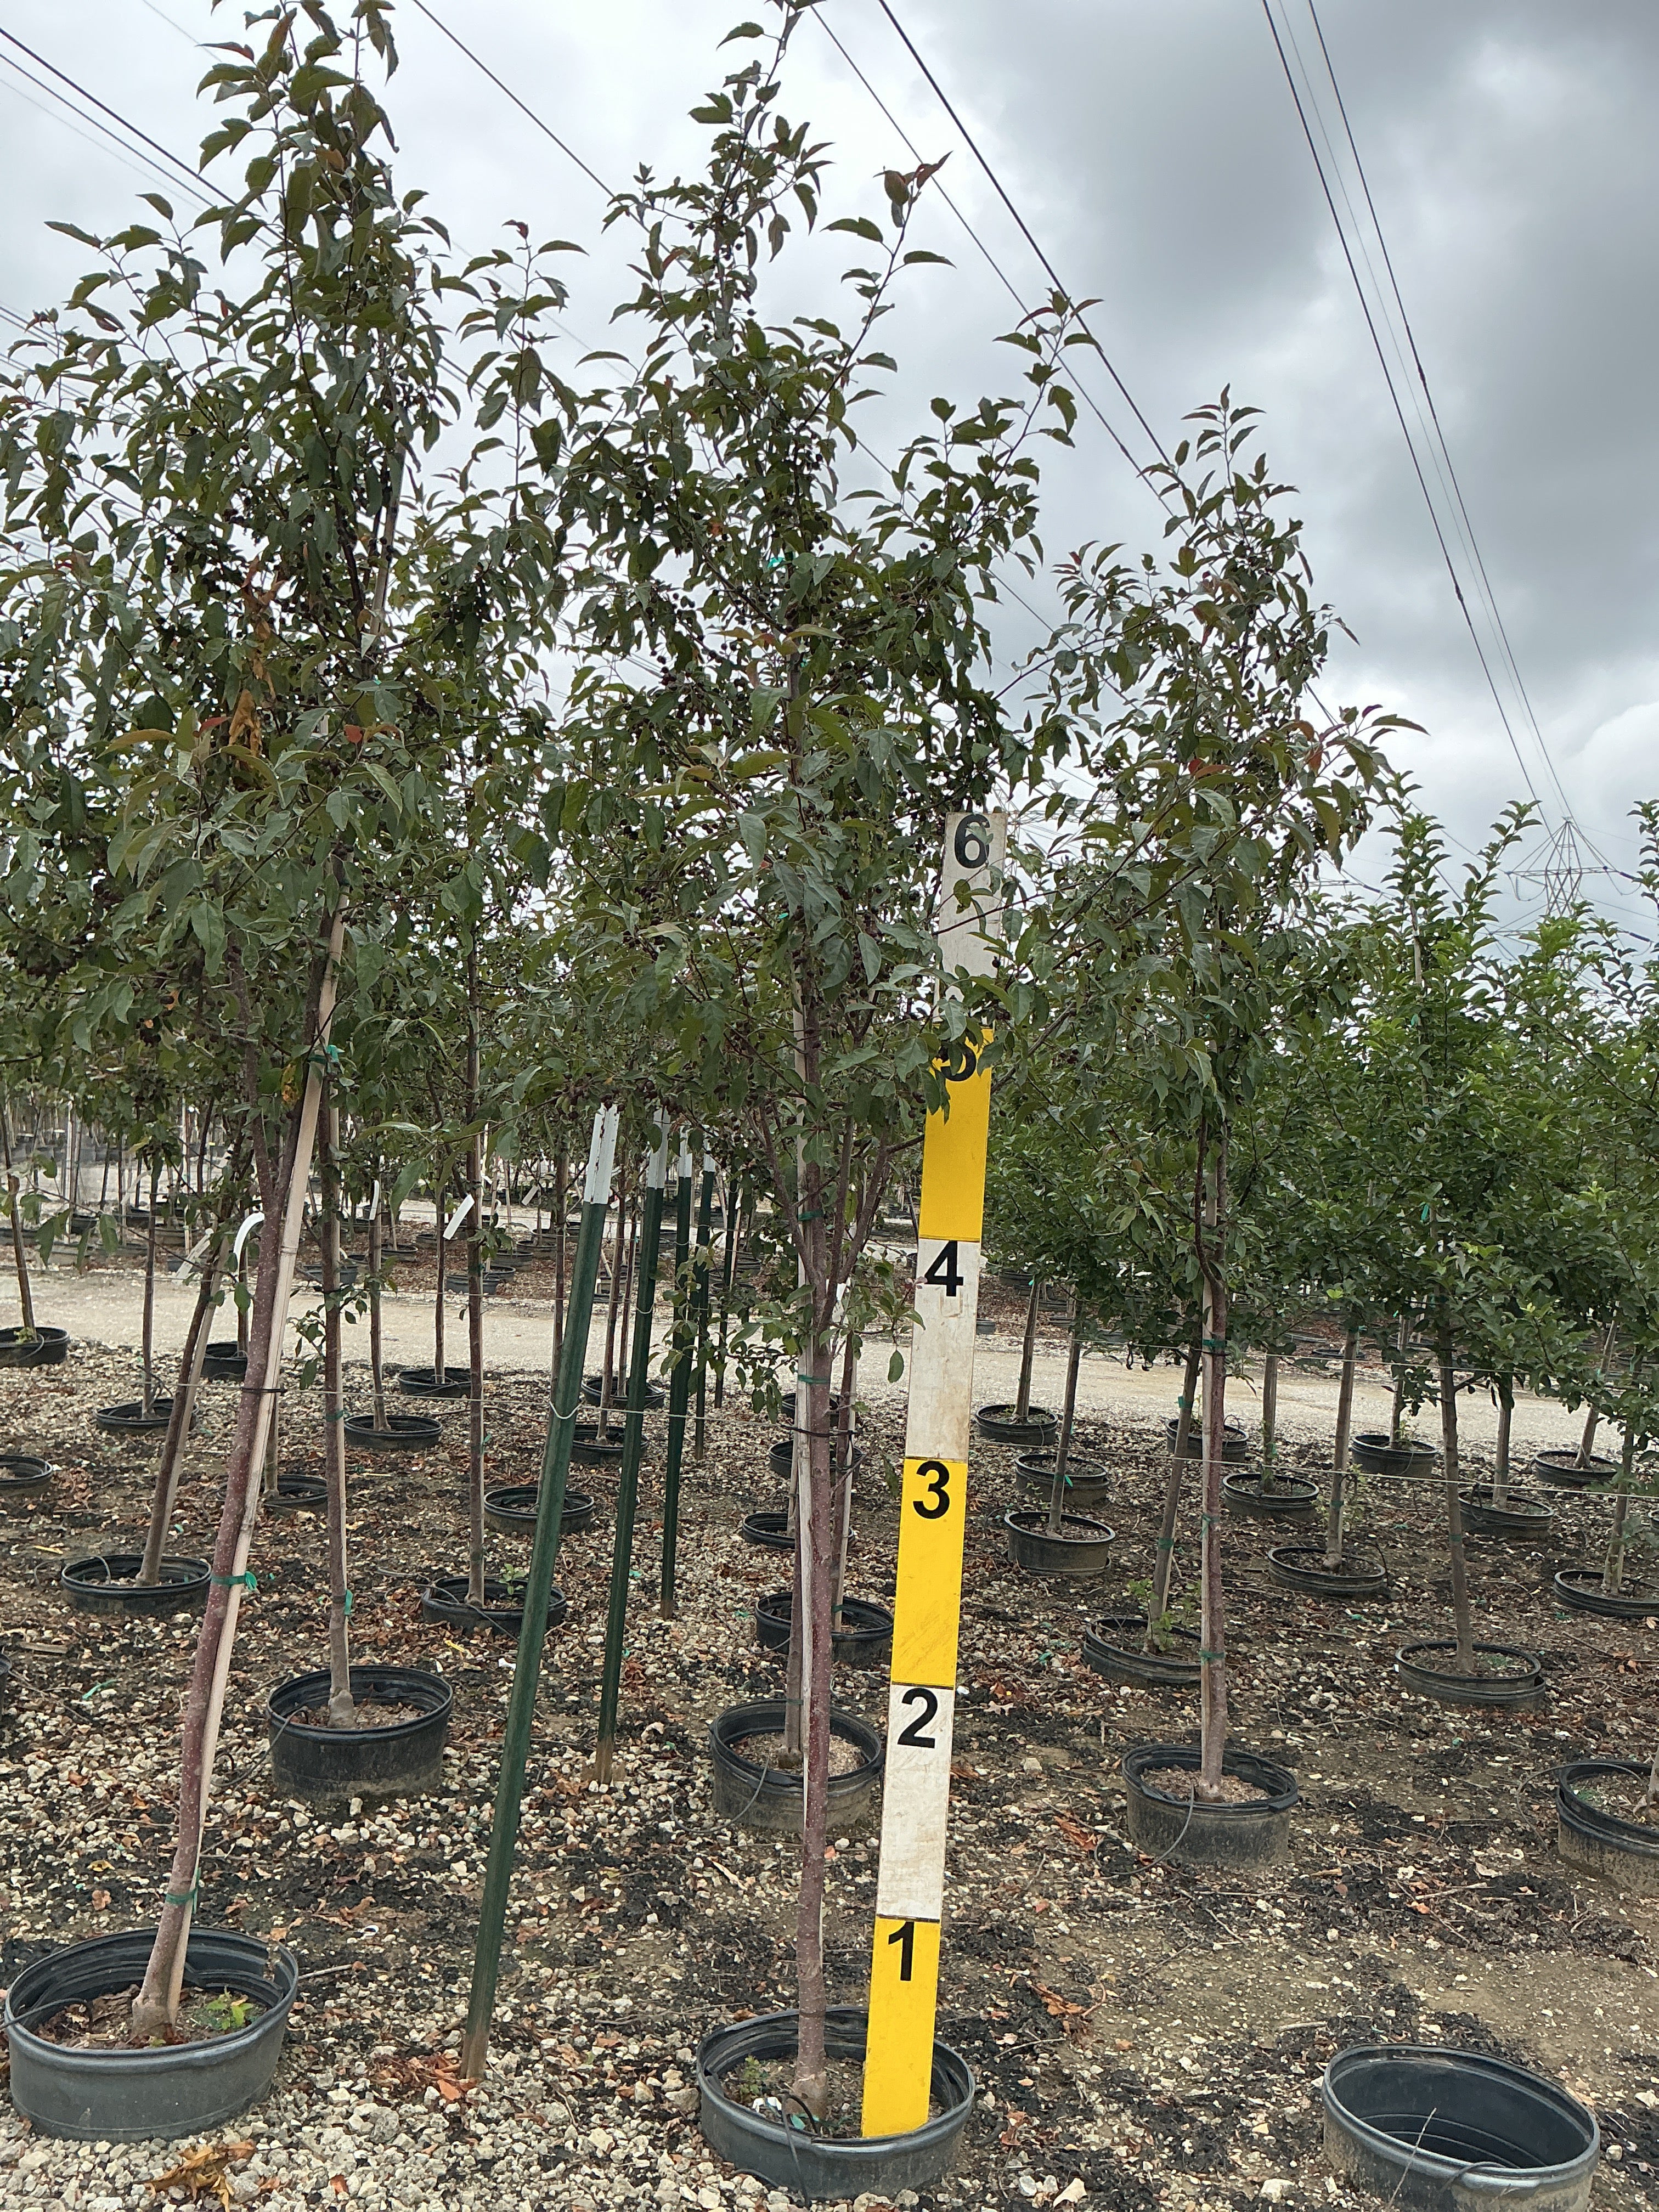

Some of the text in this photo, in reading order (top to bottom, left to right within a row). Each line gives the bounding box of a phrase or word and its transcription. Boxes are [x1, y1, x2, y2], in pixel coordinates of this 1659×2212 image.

[955, 814, 990, 868] 6
[924, 1240, 964, 1297] 4
[913, 1460, 950, 1519] 3
[897, 1688, 938, 1749] 2
[888, 1921, 915, 1981] 1
